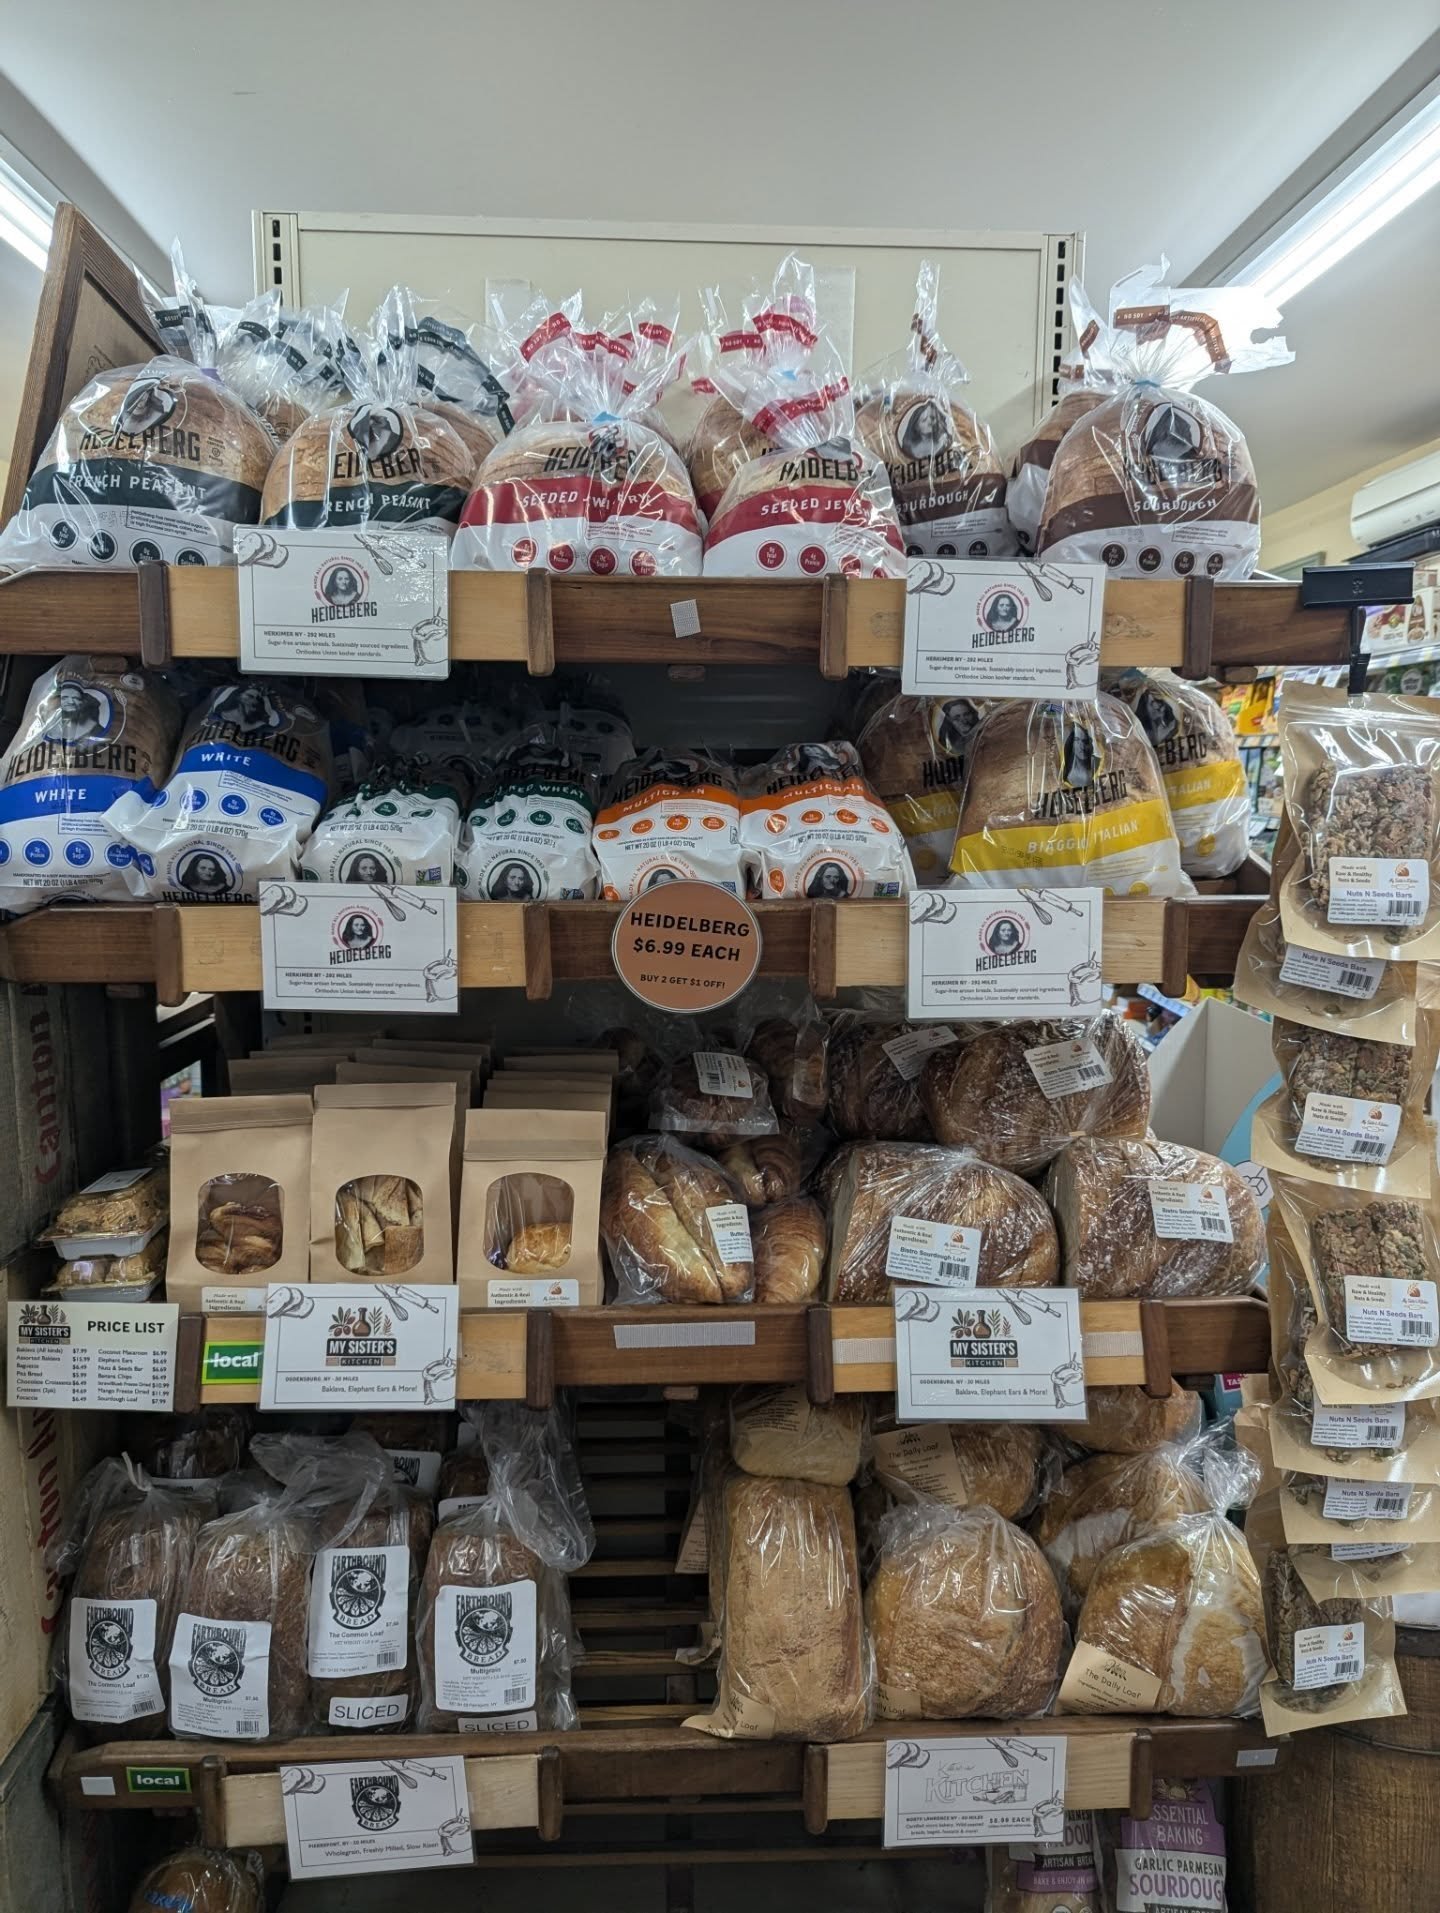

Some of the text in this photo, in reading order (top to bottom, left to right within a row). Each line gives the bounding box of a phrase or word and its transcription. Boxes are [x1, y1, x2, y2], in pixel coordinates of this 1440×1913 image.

[521, 491, 578, 509] SEEDED
[761, 498, 820, 516] SEEDED
[312, 602, 377, 623] HEIDELBERG
[972, 627, 1034, 648] HEIDELBERG
[201, 752, 251, 766] WHITE
[35, 788, 87, 803] WHITE
[539, 784, 584, 799] WHEAT
[630, 912, 750, 937] HEIDELBERG
[330, 945, 391, 965] HEIDELBERG
[633, 937, 740, 962] $6.99 EACH
[976, 950, 1036, 972] HEIDELBERG
[1302, 952, 1367, 972] Nuts N Seeds Bars
[640, 974, 659, 983] BUY
[669, 977, 688, 985] GET
[690, 978, 700, 986] $1
[704, 980, 725, 989] OFF!
[1342, 1130, 1362, 1138] Seeds
[900, 1246, 918, 1255] Bistro
[920, 1250, 951, 1260] Sourdough
[20, 1326, 69, 1337] MY SISTER'S
[87, 1320, 164, 1334] PRICE LIST
[329, 1340, 394, 1354] MY SISTER'S
[953, 1342, 1016, 1356] MY SISTER'S
[214, 1352, 258, 1368] local
[341, 1358, 380, 1366] KITCHEN
[321, 1385, 346, 1393] Baklava,
[348, 1385, 375, 1394] Elephant
[981, 1389, 1006, 1397] Elephant
[1329, 1416, 1345, 1424] Nuts
[1347, 1416, 1352, 1424] N
[340, 1615, 375, 1626] BREAD
[467, 1650, 502, 1663] BREAD
[95, 1664, 125, 1677] BREAD
[200, 1683, 234, 1693] BREAD
[1086, 1668, 1142, 1698] The Daily Loaf
[202, 1696, 232, 1704] Multigrain
[334, 1704, 399, 1720] SLICED
[464, 1720, 530, 1732] SLICED
[740, 1720, 759, 1731] Loaf
[136, 1775, 180, 1786] local
[350, 1775, 400, 1798] EARTHBOUND
[925, 1769, 1029, 1803] KITCHEN
[1151, 1804, 1208, 1825] SSENTIAL
[363, 1818, 394, 1828] BREAD
[1157, 1825, 1203, 1846] BAKING
[324, 1848, 362, 1857] Wholegrain,
[363, 1846, 384, 1854] Freshly
[1042, 1858, 1075, 1868] ARTISAN
[1134, 1857, 1224, 1877] GARLIC PARMESAN
[1129, 1876, 1225, 1901] SOURDOUG
